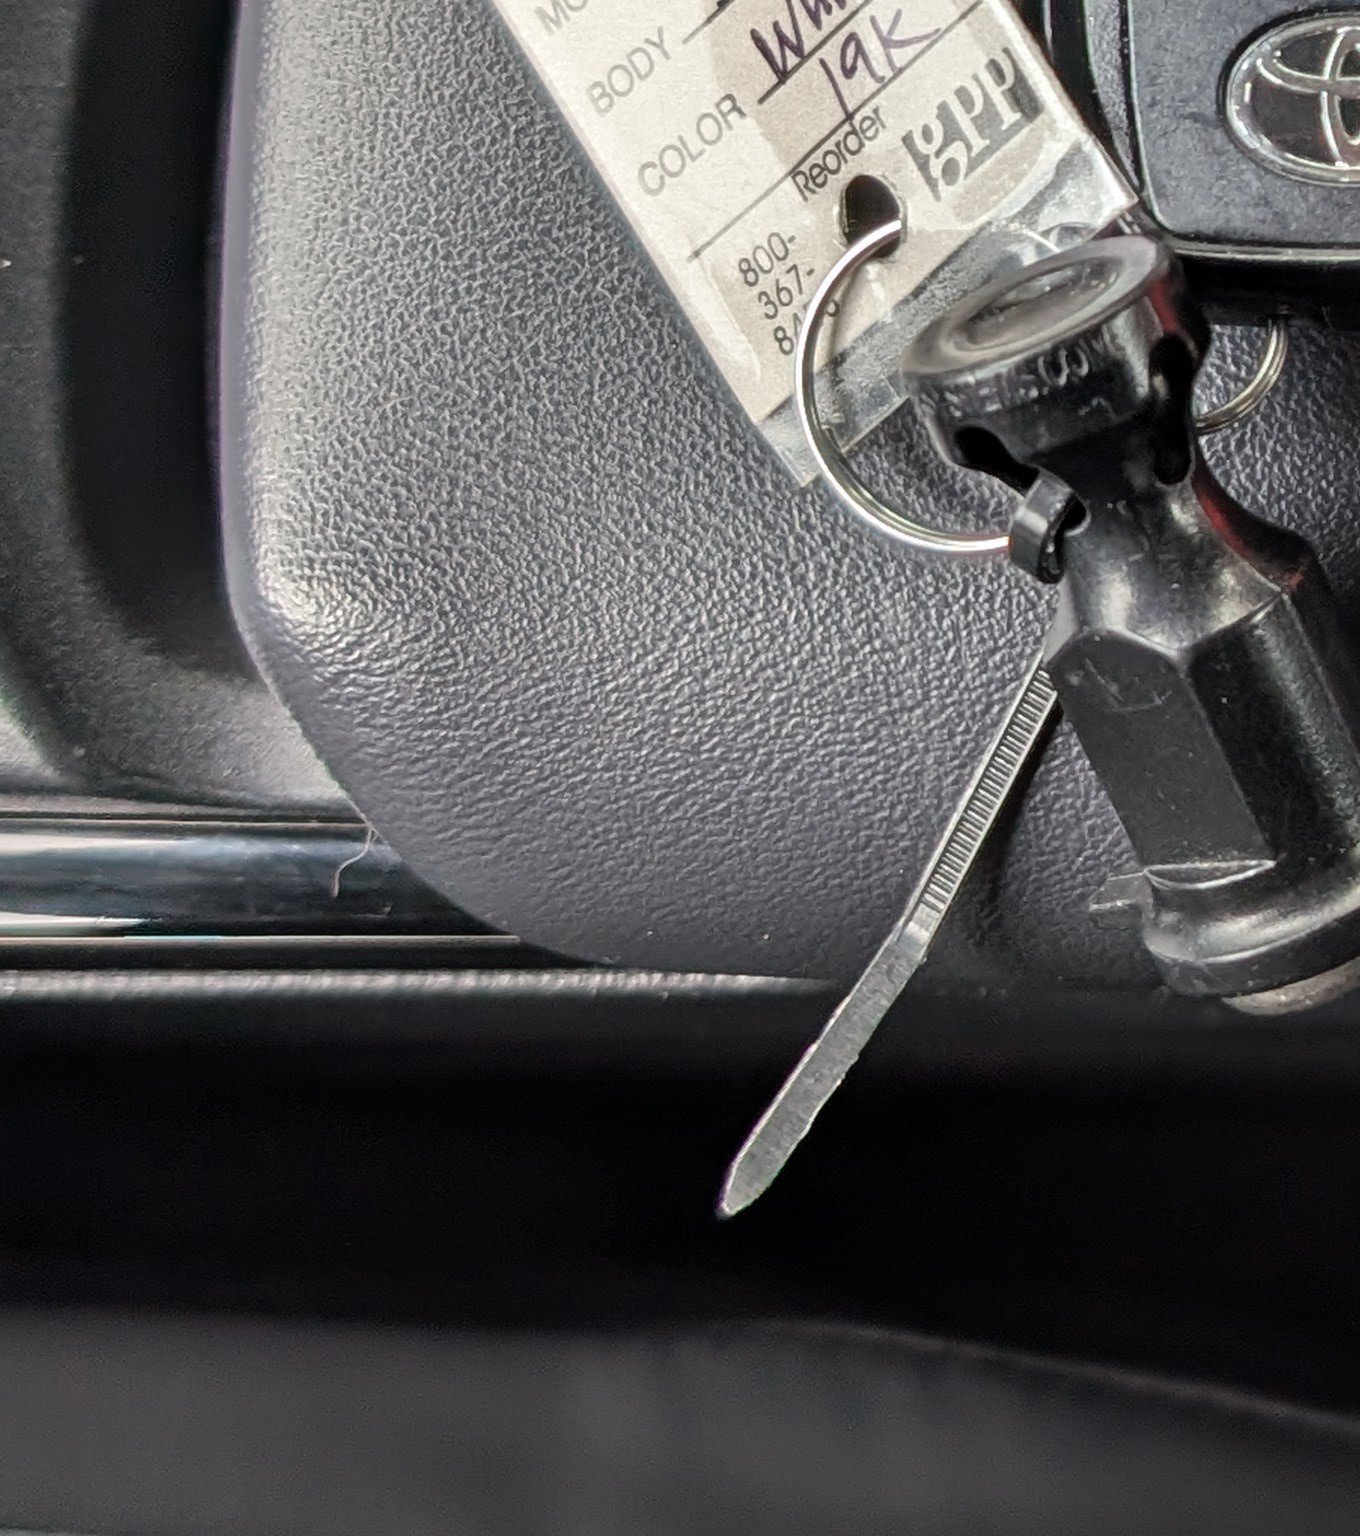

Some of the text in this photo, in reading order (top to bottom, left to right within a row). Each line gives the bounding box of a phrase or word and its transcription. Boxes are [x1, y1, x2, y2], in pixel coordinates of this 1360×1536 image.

[587, 29, 672, 115] BODY
[823, 9, 941, 120] 19K
[639, 92, 748, 197] COLOR
[790, 107, 887, 203] Reorder
[738, 232, 796, 287] 800-
[758, 264, 815, 319] 367-
